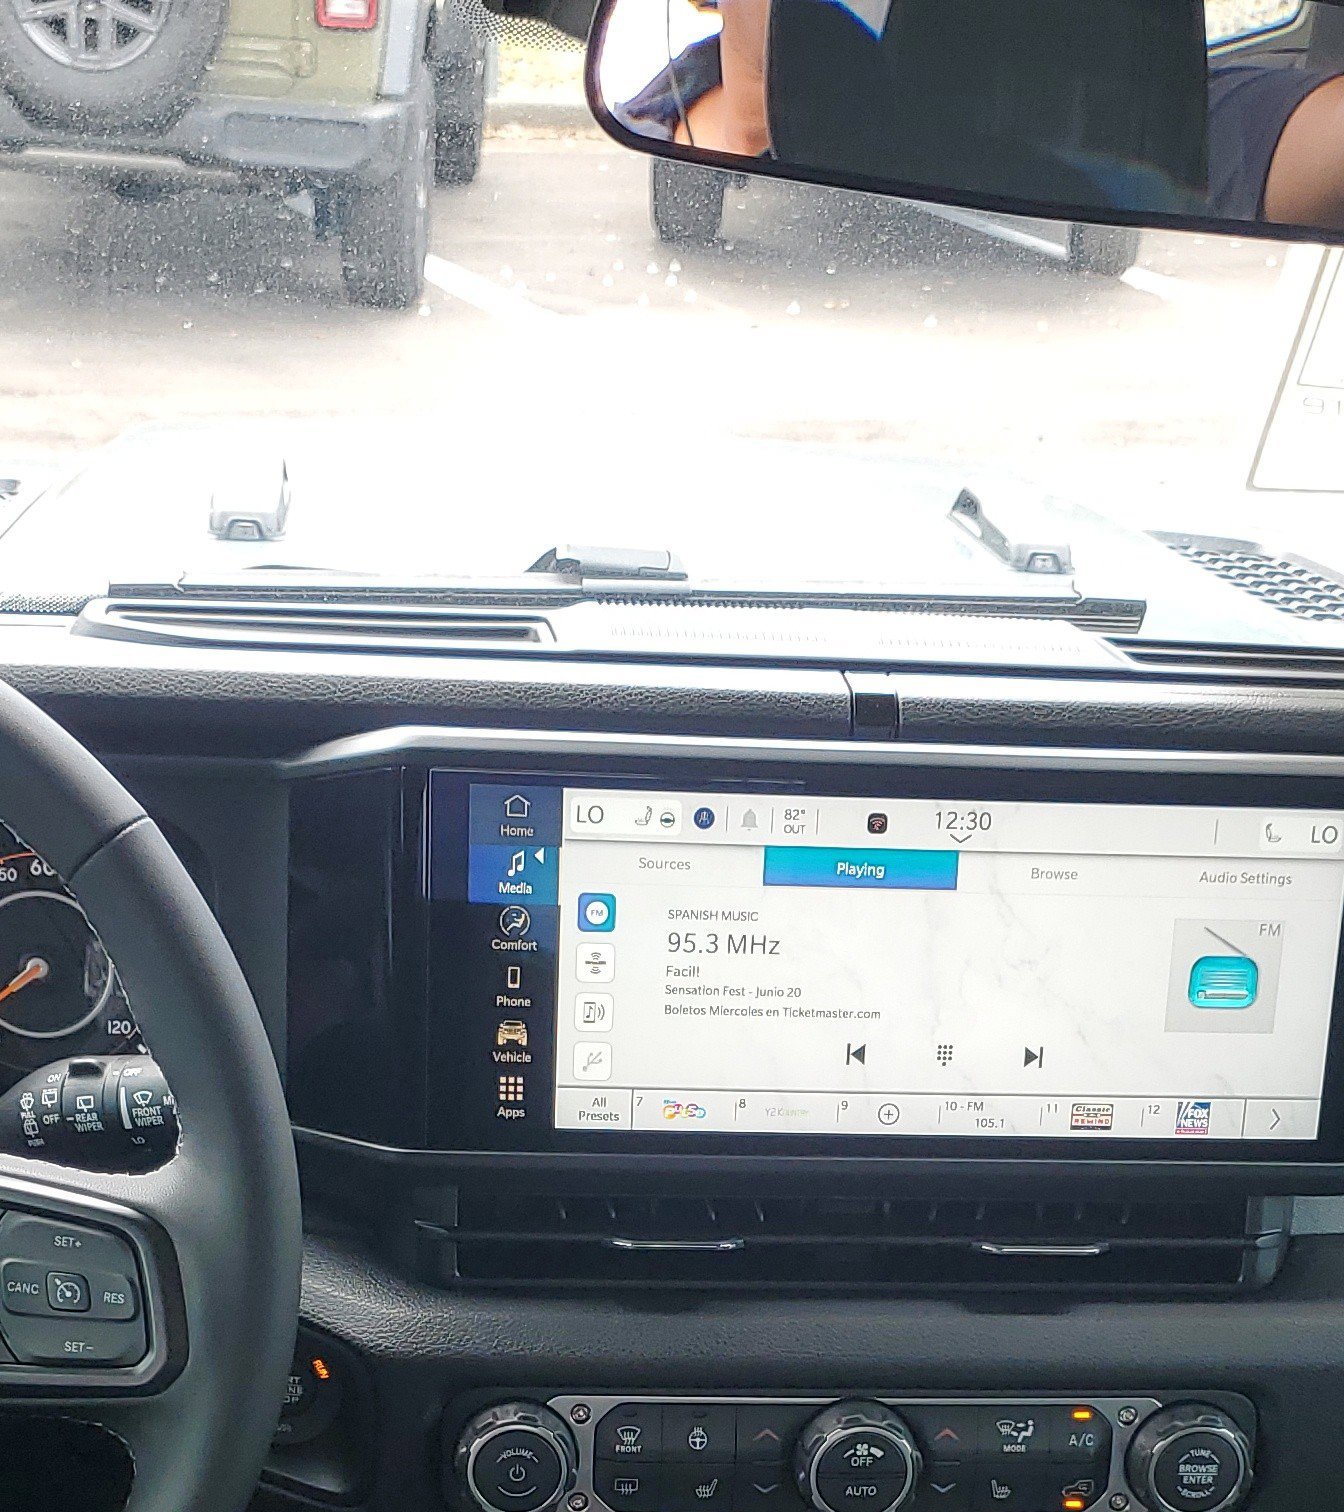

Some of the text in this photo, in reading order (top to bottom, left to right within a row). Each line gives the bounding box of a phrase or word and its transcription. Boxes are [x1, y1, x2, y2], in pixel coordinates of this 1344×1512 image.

[576, 804, 604, 825] LO
[784, 809, 806, 821] 82°
[934, 811, 992, 831] 12:30
[500, 825, 534, 838] Home
[783, 824, 806, 835] OUT
[1310, 825, 1339, 845] LO
[638, 857, 691, 871] Sources
[836, 862, 886, 879] Playing
[1031, 867, 1078, 881] Browse
[1199, 871, 1293, 887] Audio Settings
[498, 881, 534, 895] Media
[667, 909, 759, 922] SPANISH MUSIC
[1258, 923, 1282, 937] FM
[491, 938, 538, 952] Comfort
[668, 932, 781, 955] 95.3 MHz
[664, 985, 802, 999] Sensation Fest Junio 20
[496, 995, 531, 1008] Phone
[664, 1004, 881, 1020] Boletos Miercoles en Ticketmaster.com
[107, 1020, 131, 1035] 120
[492, 1051, 532, 1063] Vehicle
[47, 1073, 62, 1083] ON
[591, 1096, 607, 1109] All
[944, 1101, 984, 1112] 10 FM
[132, 1105, 162, 1119] FRONT
[496, 1106, 526, 1120] Apps
[1147, 1104, 1161, 1115] 12
[1188, 1108, 1209, 1119] FOX
[42, 1113, 60, 1125] OFF
[75, 1112, 98, 1123] REAR
[134, 1114, 165, 1127] WIPER
[578, 1110, 621, 1123] Presets
[74, 1121, 104, 1133] WIPER
[974, 1118, 1005, 1129] 105.1
[1181, 1119, 1209, 1128] NEWS
[53, 1235, 82, 1249] SET+
[6, 1281, 40, 1296] CANC
[103, 1292, 125, 1304] RES
[1068, 1433, 1094, 1447] A/C
[500, 1447, 534, 1461] VOLUME
[614, 1444, 642, 1454] FRONT
[1003, 1444, 1027, 1453] MODE
[1188, 1448, 1211, 1459] TUNE
[850, 1456, 874, 1468] OFF
[1178, 1463, 1218, 1474] BROWSE
[1182, 1475, 1214, 1486] ENTER
[845, 1485, 878, 1498] AUTO
[1180, 1486, 1211, 1499] SCROLL
